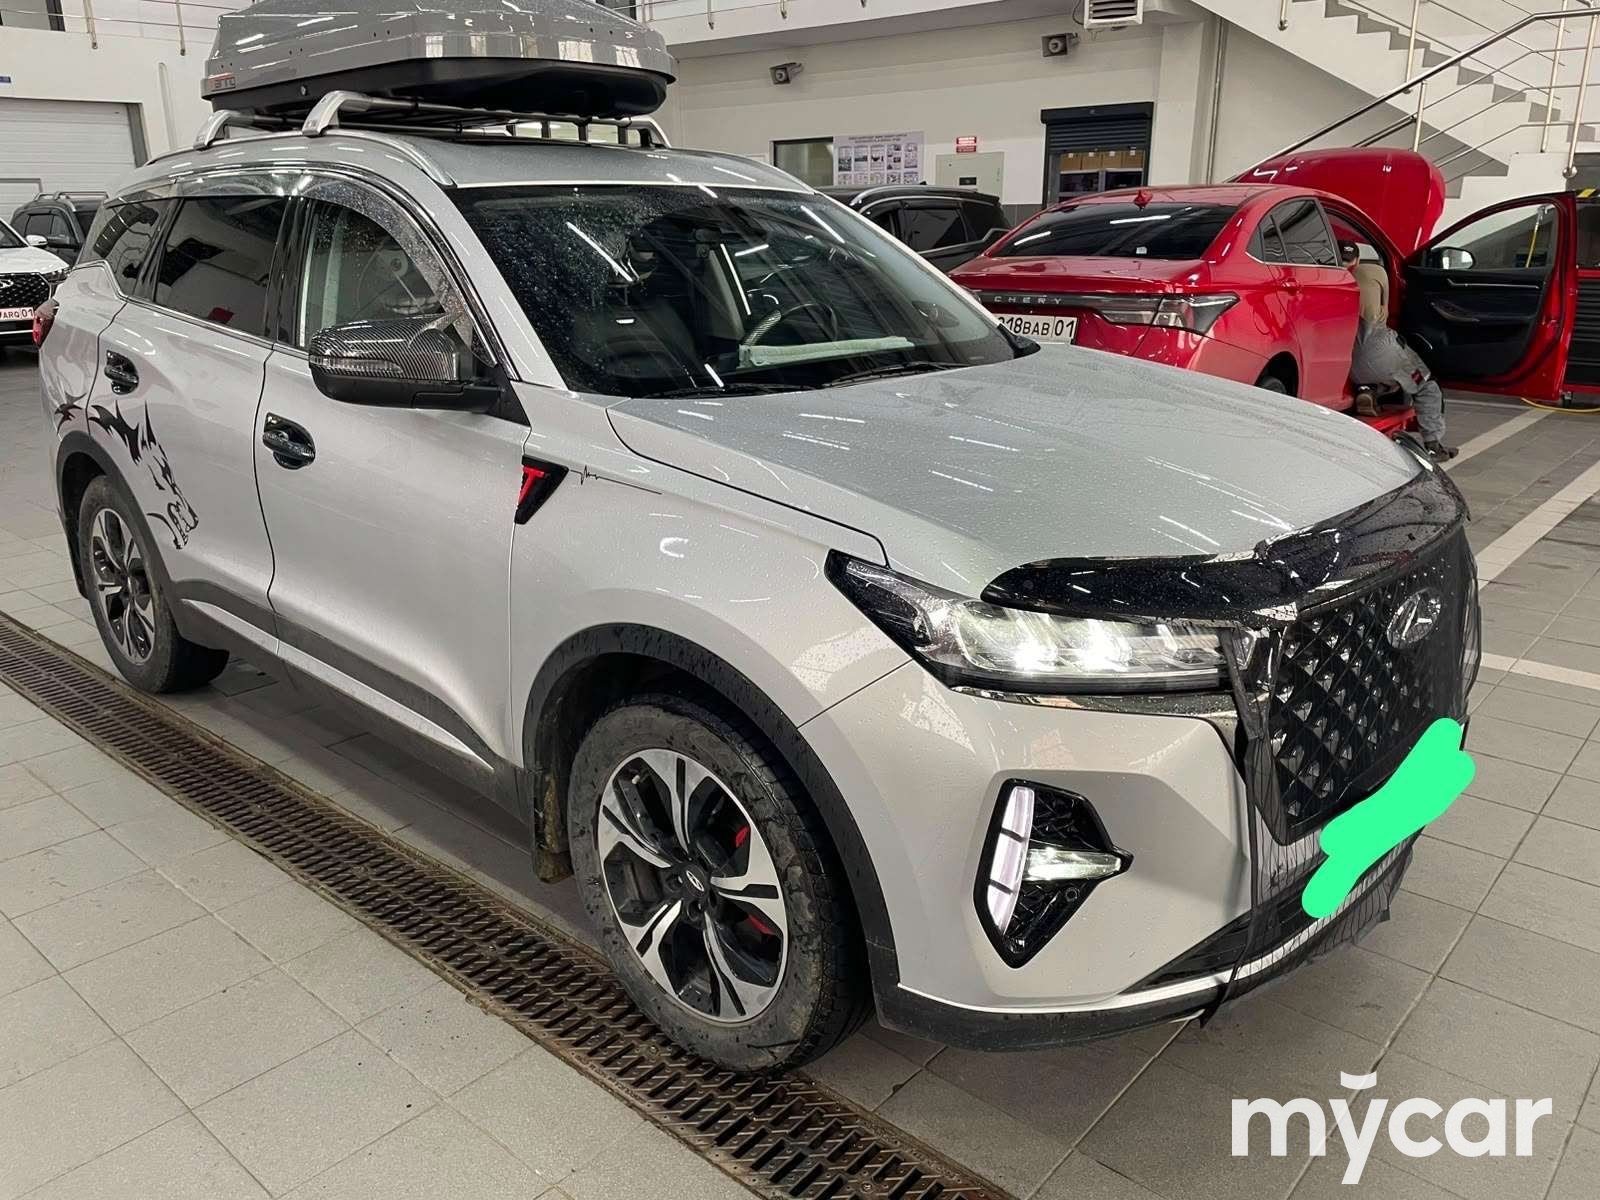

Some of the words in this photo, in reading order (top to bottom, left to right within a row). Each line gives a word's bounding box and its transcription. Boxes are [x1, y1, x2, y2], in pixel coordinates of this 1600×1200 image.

[994, 296, 1062, 304] CHERY
[21, 309, 34, 317] 01
[1054, 320, 1075, 337] 01
